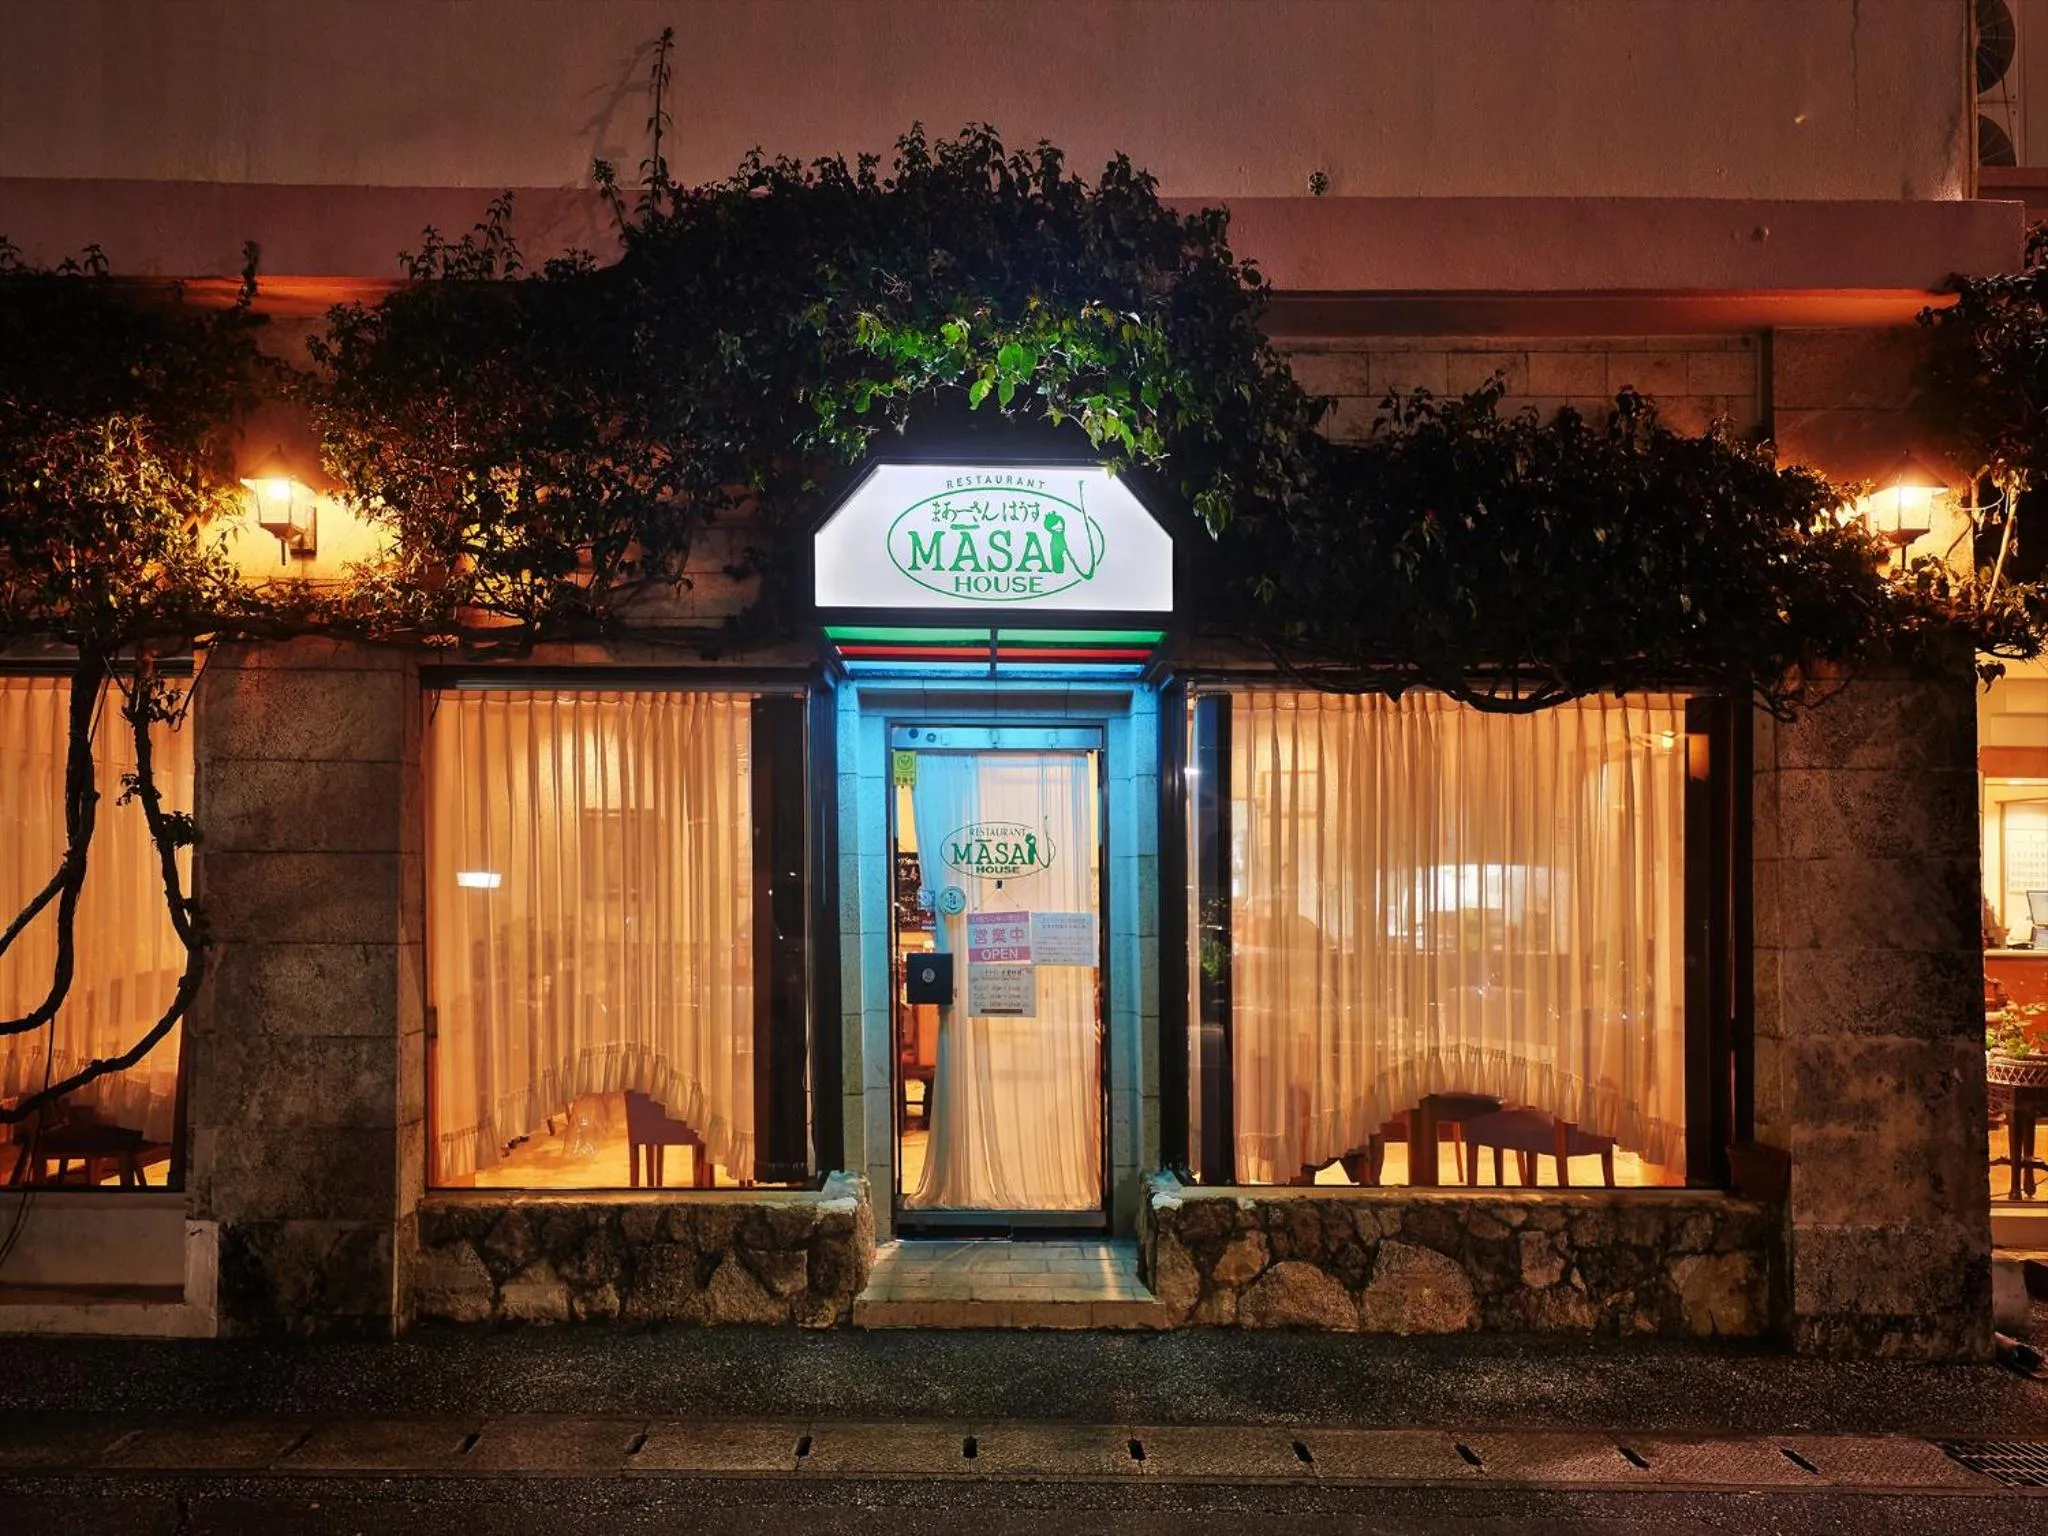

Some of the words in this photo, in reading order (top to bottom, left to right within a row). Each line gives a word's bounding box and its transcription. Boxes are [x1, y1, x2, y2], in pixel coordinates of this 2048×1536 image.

[946, 475, 1047, 489] RESTAURANT
[954, 576, 1044, 594] HOUSE
[969, 827, 1026, 837] RESTAURANT
[975, 865, 1021, 874] HOUSE
[974, 926, 1025, 945] 営業中
[981, 948, 1019, 961] OPEN
